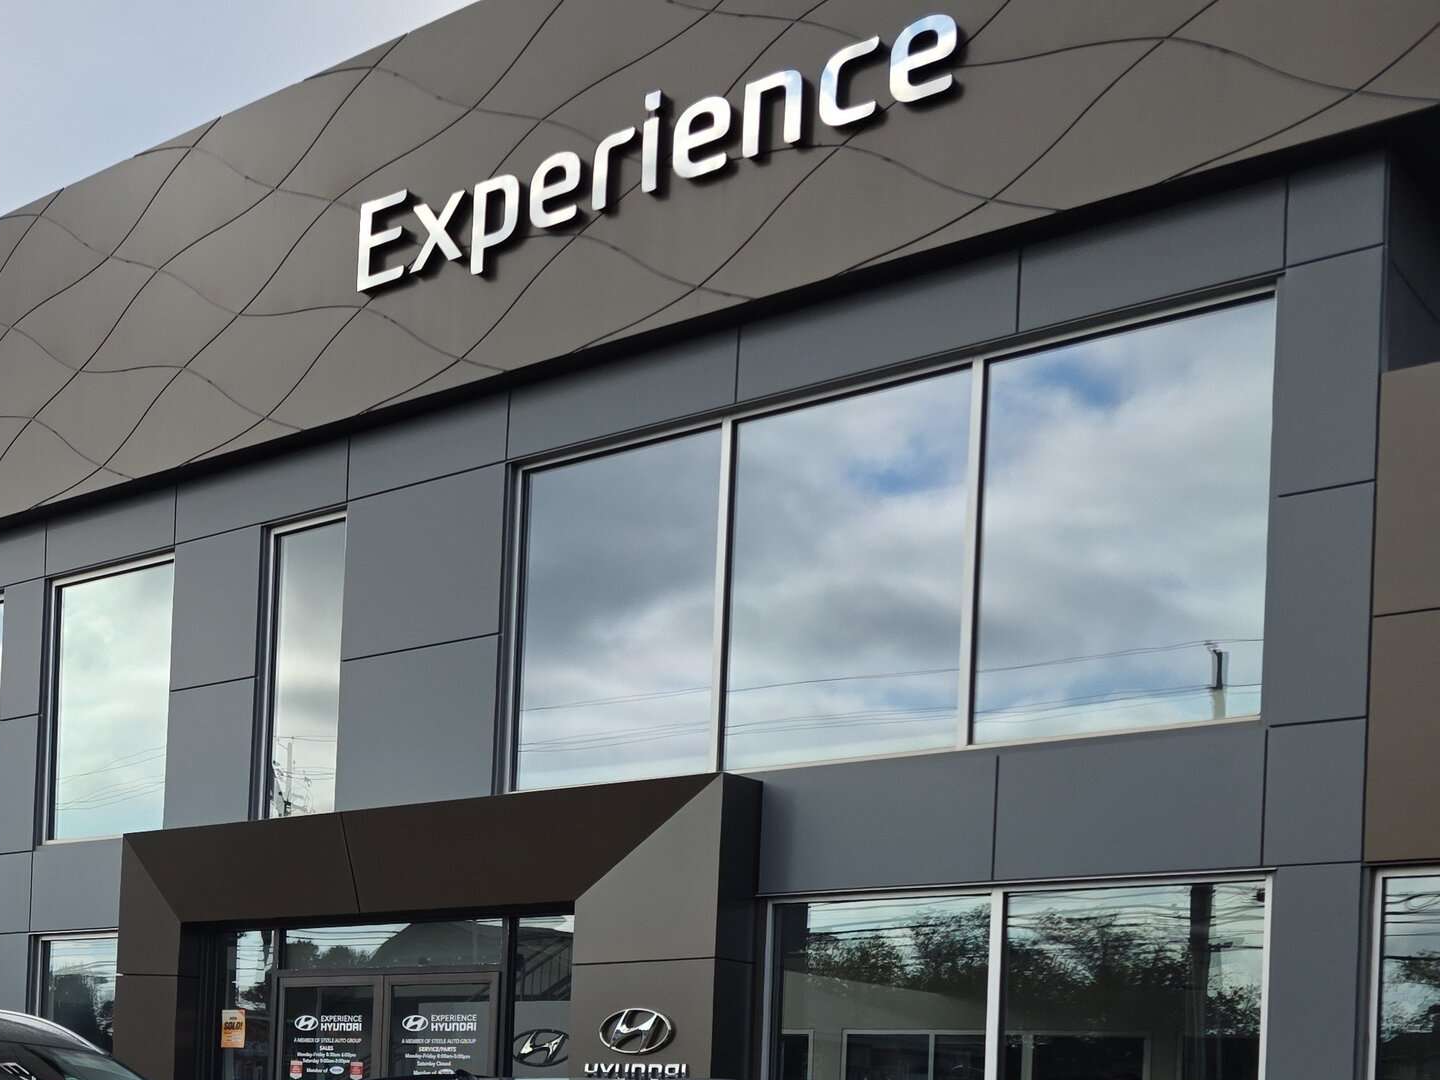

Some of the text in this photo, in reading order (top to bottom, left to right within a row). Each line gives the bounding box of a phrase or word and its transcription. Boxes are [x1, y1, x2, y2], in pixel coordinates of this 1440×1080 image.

[356, 13, 959, 293] Experience
[320, 1014, 363, 1023] EXPERIENCE
[431, 1014, 478, 1022] EXPERIENCE
[223, 1021, 243, 1031] SOLD!
[320, 1022, 362, 1032] HYUNDAI
[431, 1021, 477, 1032] HYUNDAI
